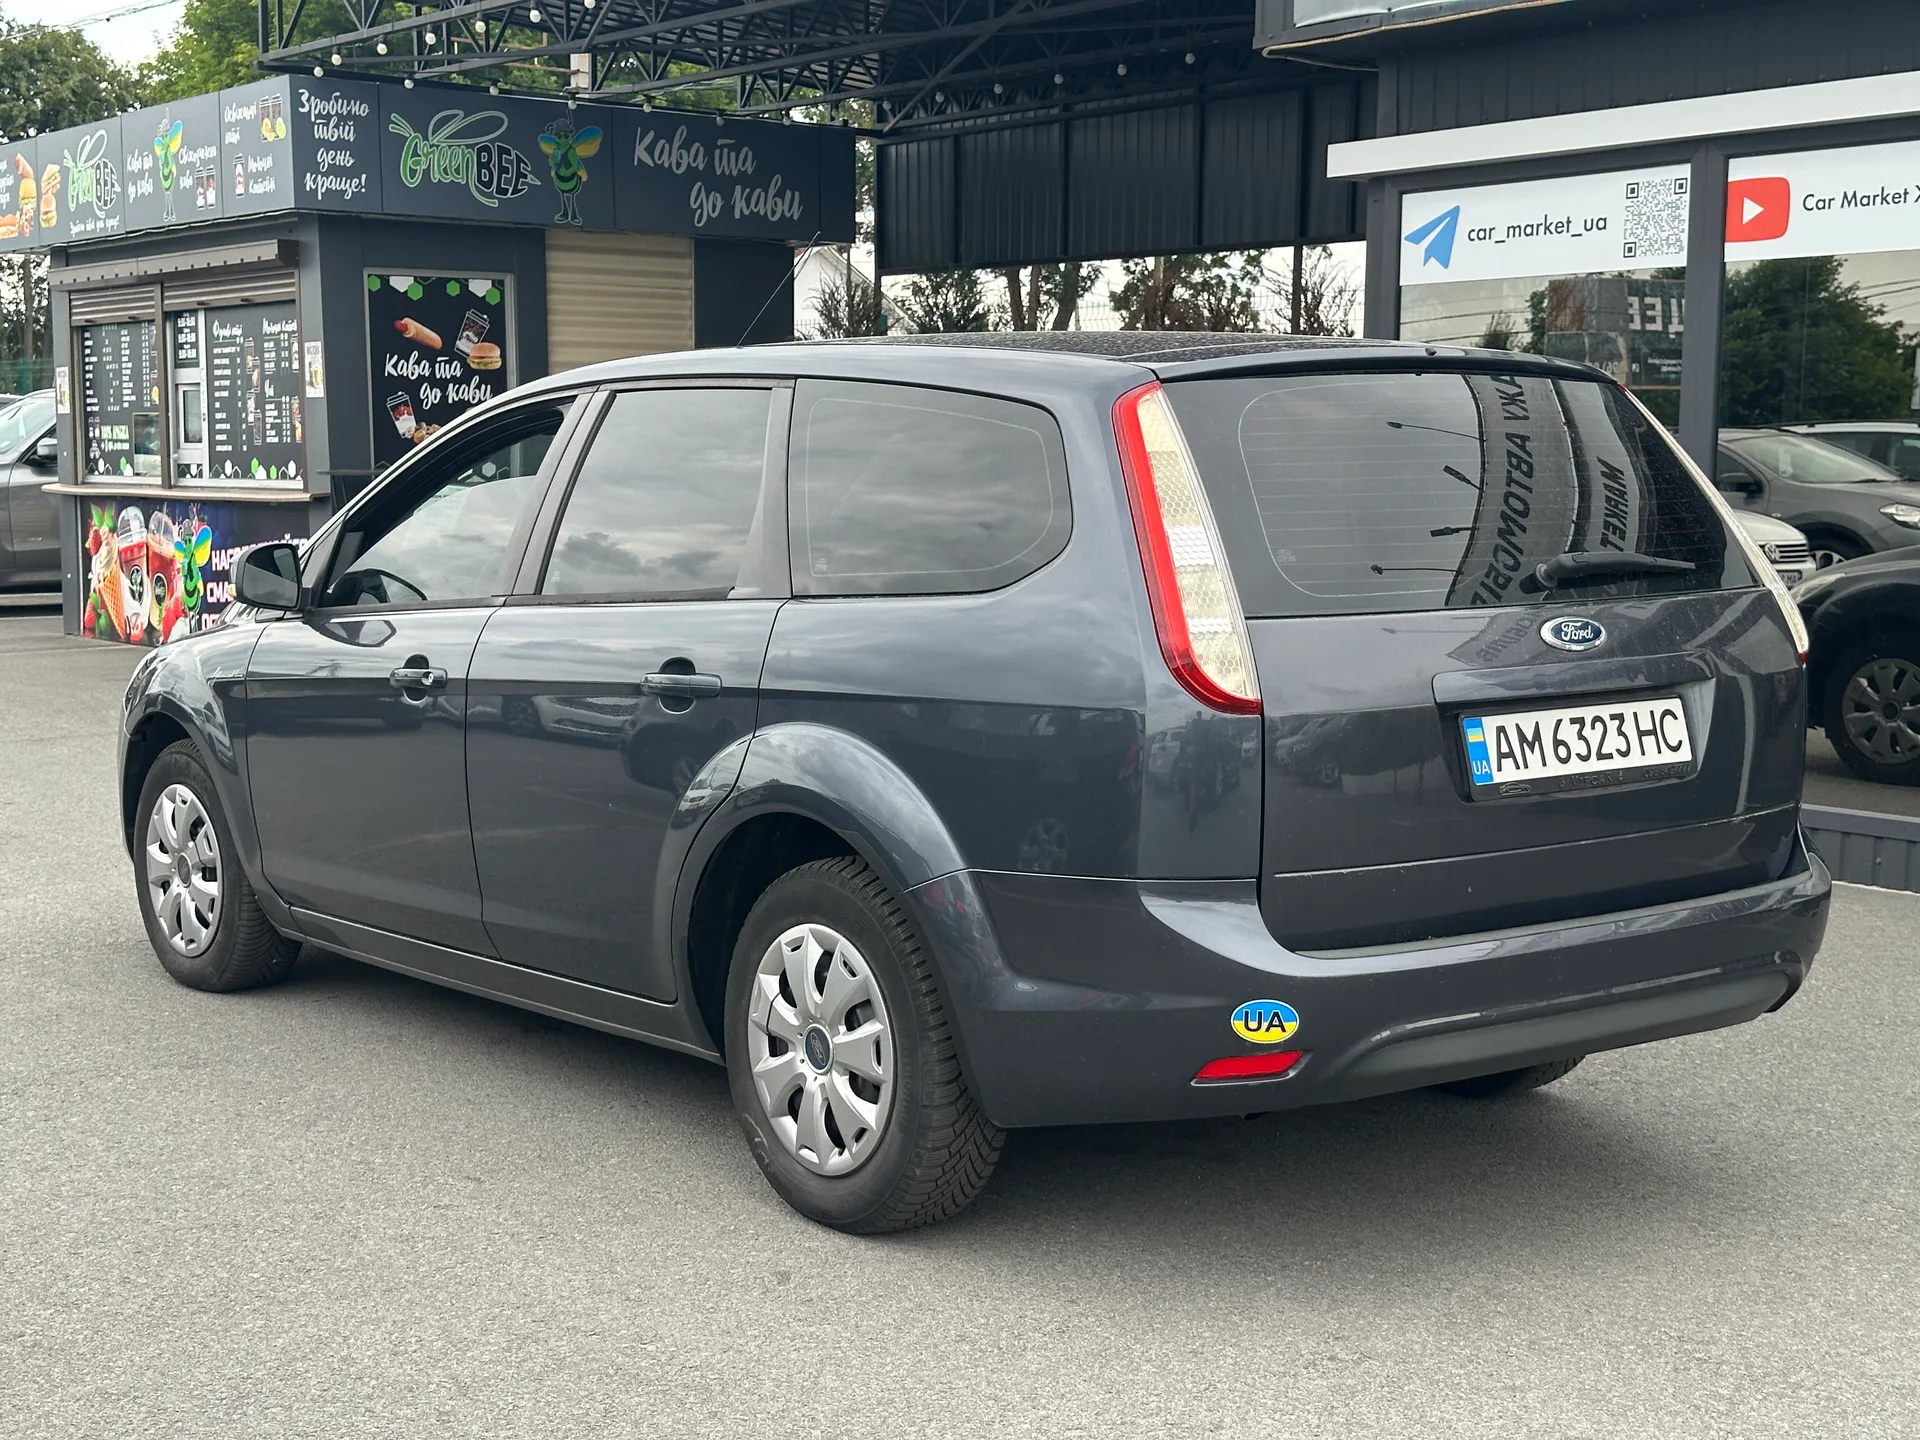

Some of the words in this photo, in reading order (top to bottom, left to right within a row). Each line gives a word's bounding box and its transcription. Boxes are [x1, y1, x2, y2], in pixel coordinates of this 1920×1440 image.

[298, 88, 370, 122] Зробимо
[314, 119, 356, 142] твій
[317, 147, 355, 172] день
[633, 125, 708, 175] Кава
[714, 138, 757, 177] та
[304, 172, 367, 200] краще!
[689, 181, 724, 227] до
[730, 174, 804, 221] кави
[1803, 191, 1835, 212] Car
[1841, 185, 1909, 209] Market
[1467, 213, 1608, 244] car_market_ua
[384, 350, 432, 380] Кава
[434, 356, 464, 380] та
[419, 382, 442, 410] до
[446, 375, 493, 404] кави
[1561, 621, 1593, 641] Ford
[1495, 721, 1547, 772] AM
[1552, 712, 1631, 765] 6323
[1633, 708, 1683, 757] HC
[1473, 760, 1491, 776] UA
[1243, 1009, 1287, 1033] UA
